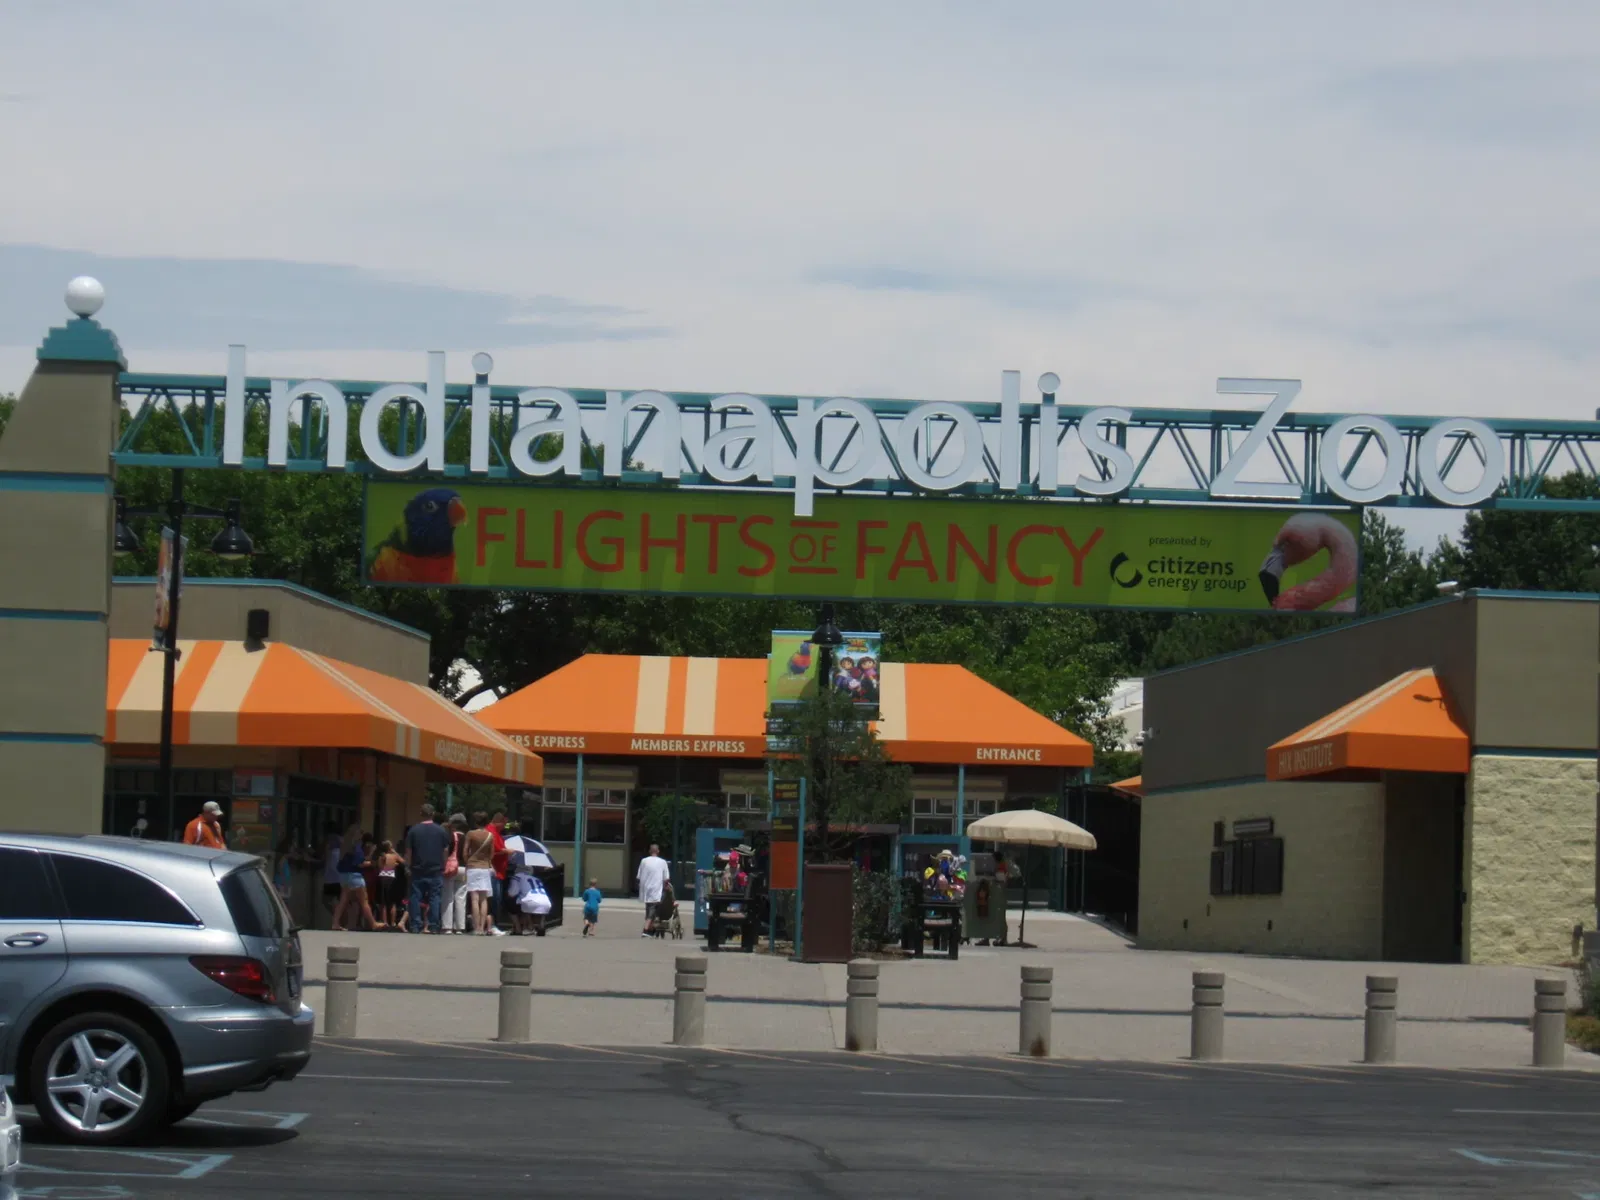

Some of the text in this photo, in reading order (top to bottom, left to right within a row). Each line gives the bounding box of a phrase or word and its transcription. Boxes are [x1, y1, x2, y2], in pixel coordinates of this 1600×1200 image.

[223, 344, 1503, 518] Indianapolis Zoo
[475, 507, 1104, 588] FLIGHTS OF FANCY
[1149, 536, 1212, 548] presented by
[1147, 556, 1234, 576] citizens
[1147, 575, 1199, 592] energy
[533, 735, 585, 749] EXPRESS
[630, 738, 746, 753] MEMBERS EXPRESS
[976, 747, 1042, 762] ENTRANCE
